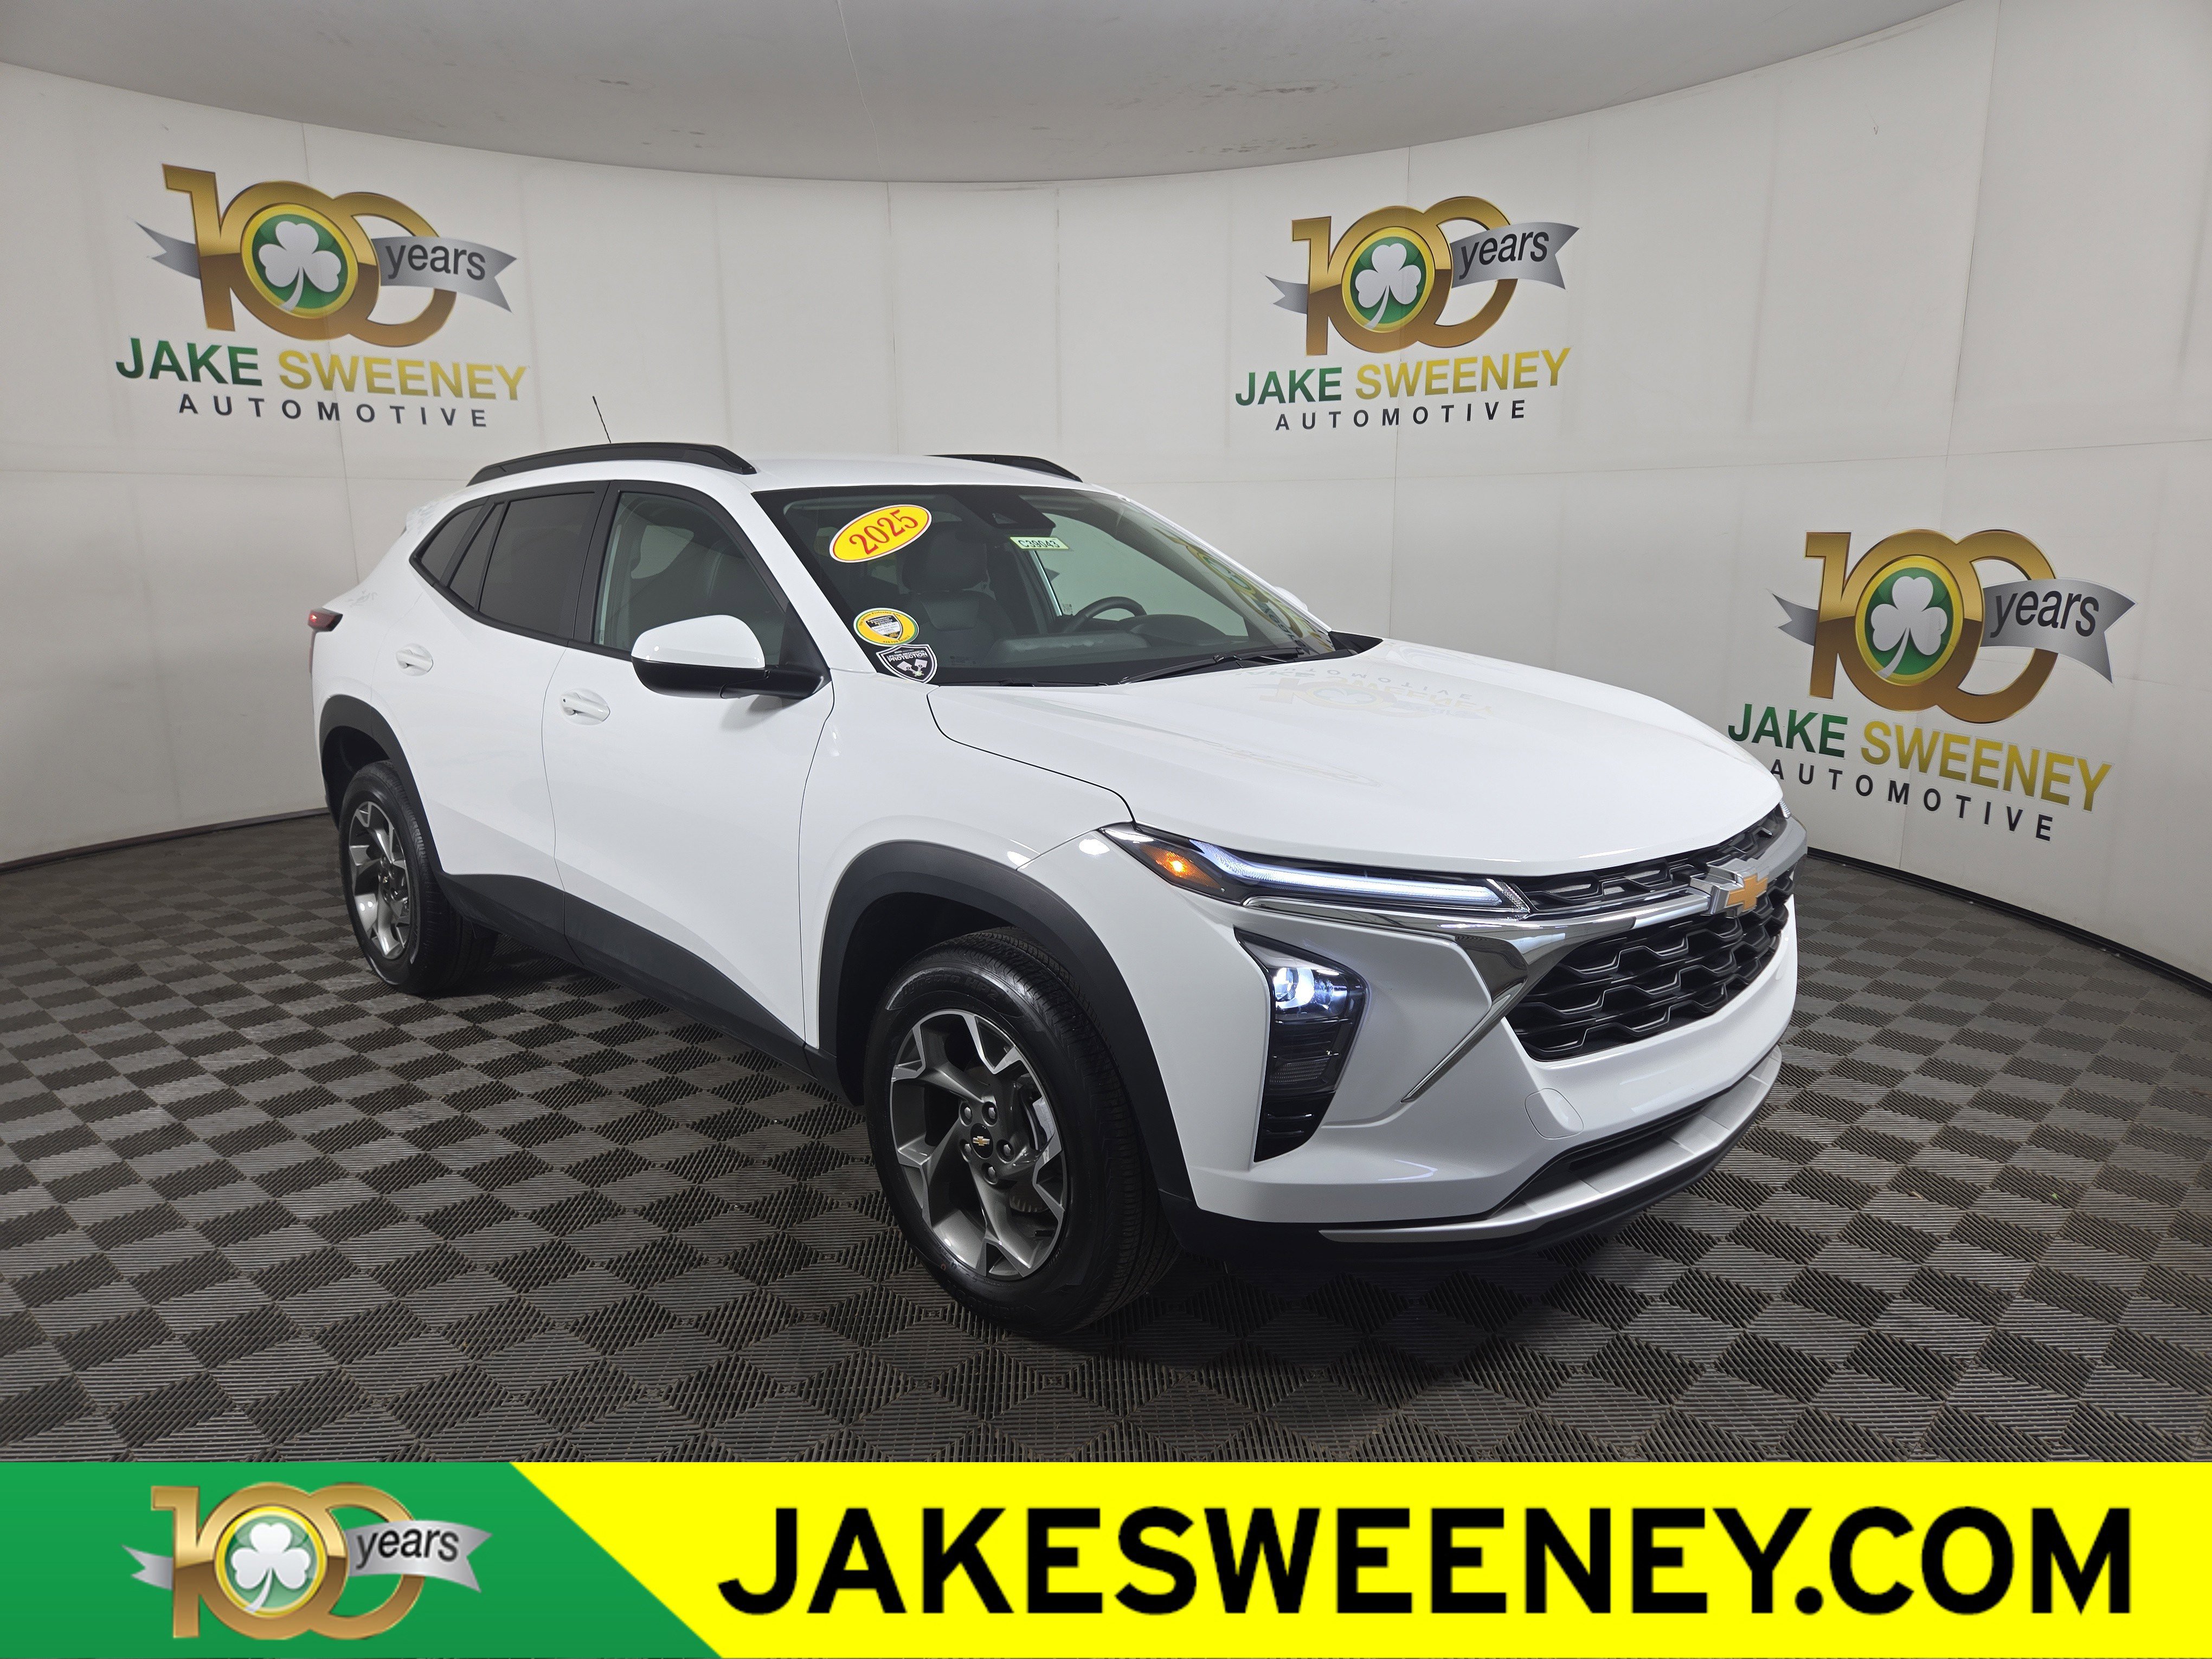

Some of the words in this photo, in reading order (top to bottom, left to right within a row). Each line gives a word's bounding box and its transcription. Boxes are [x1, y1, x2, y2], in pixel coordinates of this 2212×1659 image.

[163, 164, 456, 348] 100
[382, 238, 486, 283] years
[1291, 196, 1518, 356] 100
[1459, 230, 1549, 280] years
[115, 337, 262, 387] JAKE
[278, 350, 526, 401] SWEENEY
[1235, 366, 1342, 406] JAKE
[1355, 348, 1571, 400] SWEENEY
[179, 394, 486, 427] AUTOMOTIVE
[1275, 400, 1525, 431] AUTOMOTIVE
[849, 509, 918, 555] 2025
[1018, 540, 1060, 548] C39043
[1804, 529, 2059, 724] 100
[1990, 590, 2100, 639] years
[887, 652, 928, 663] PROTECTION
[1728, 703, 1848, 759] JAKE
[1861, 721, 2112, 812] SWEENEY
[1771, 759, 2053, 841] AUTOMOTIVE
